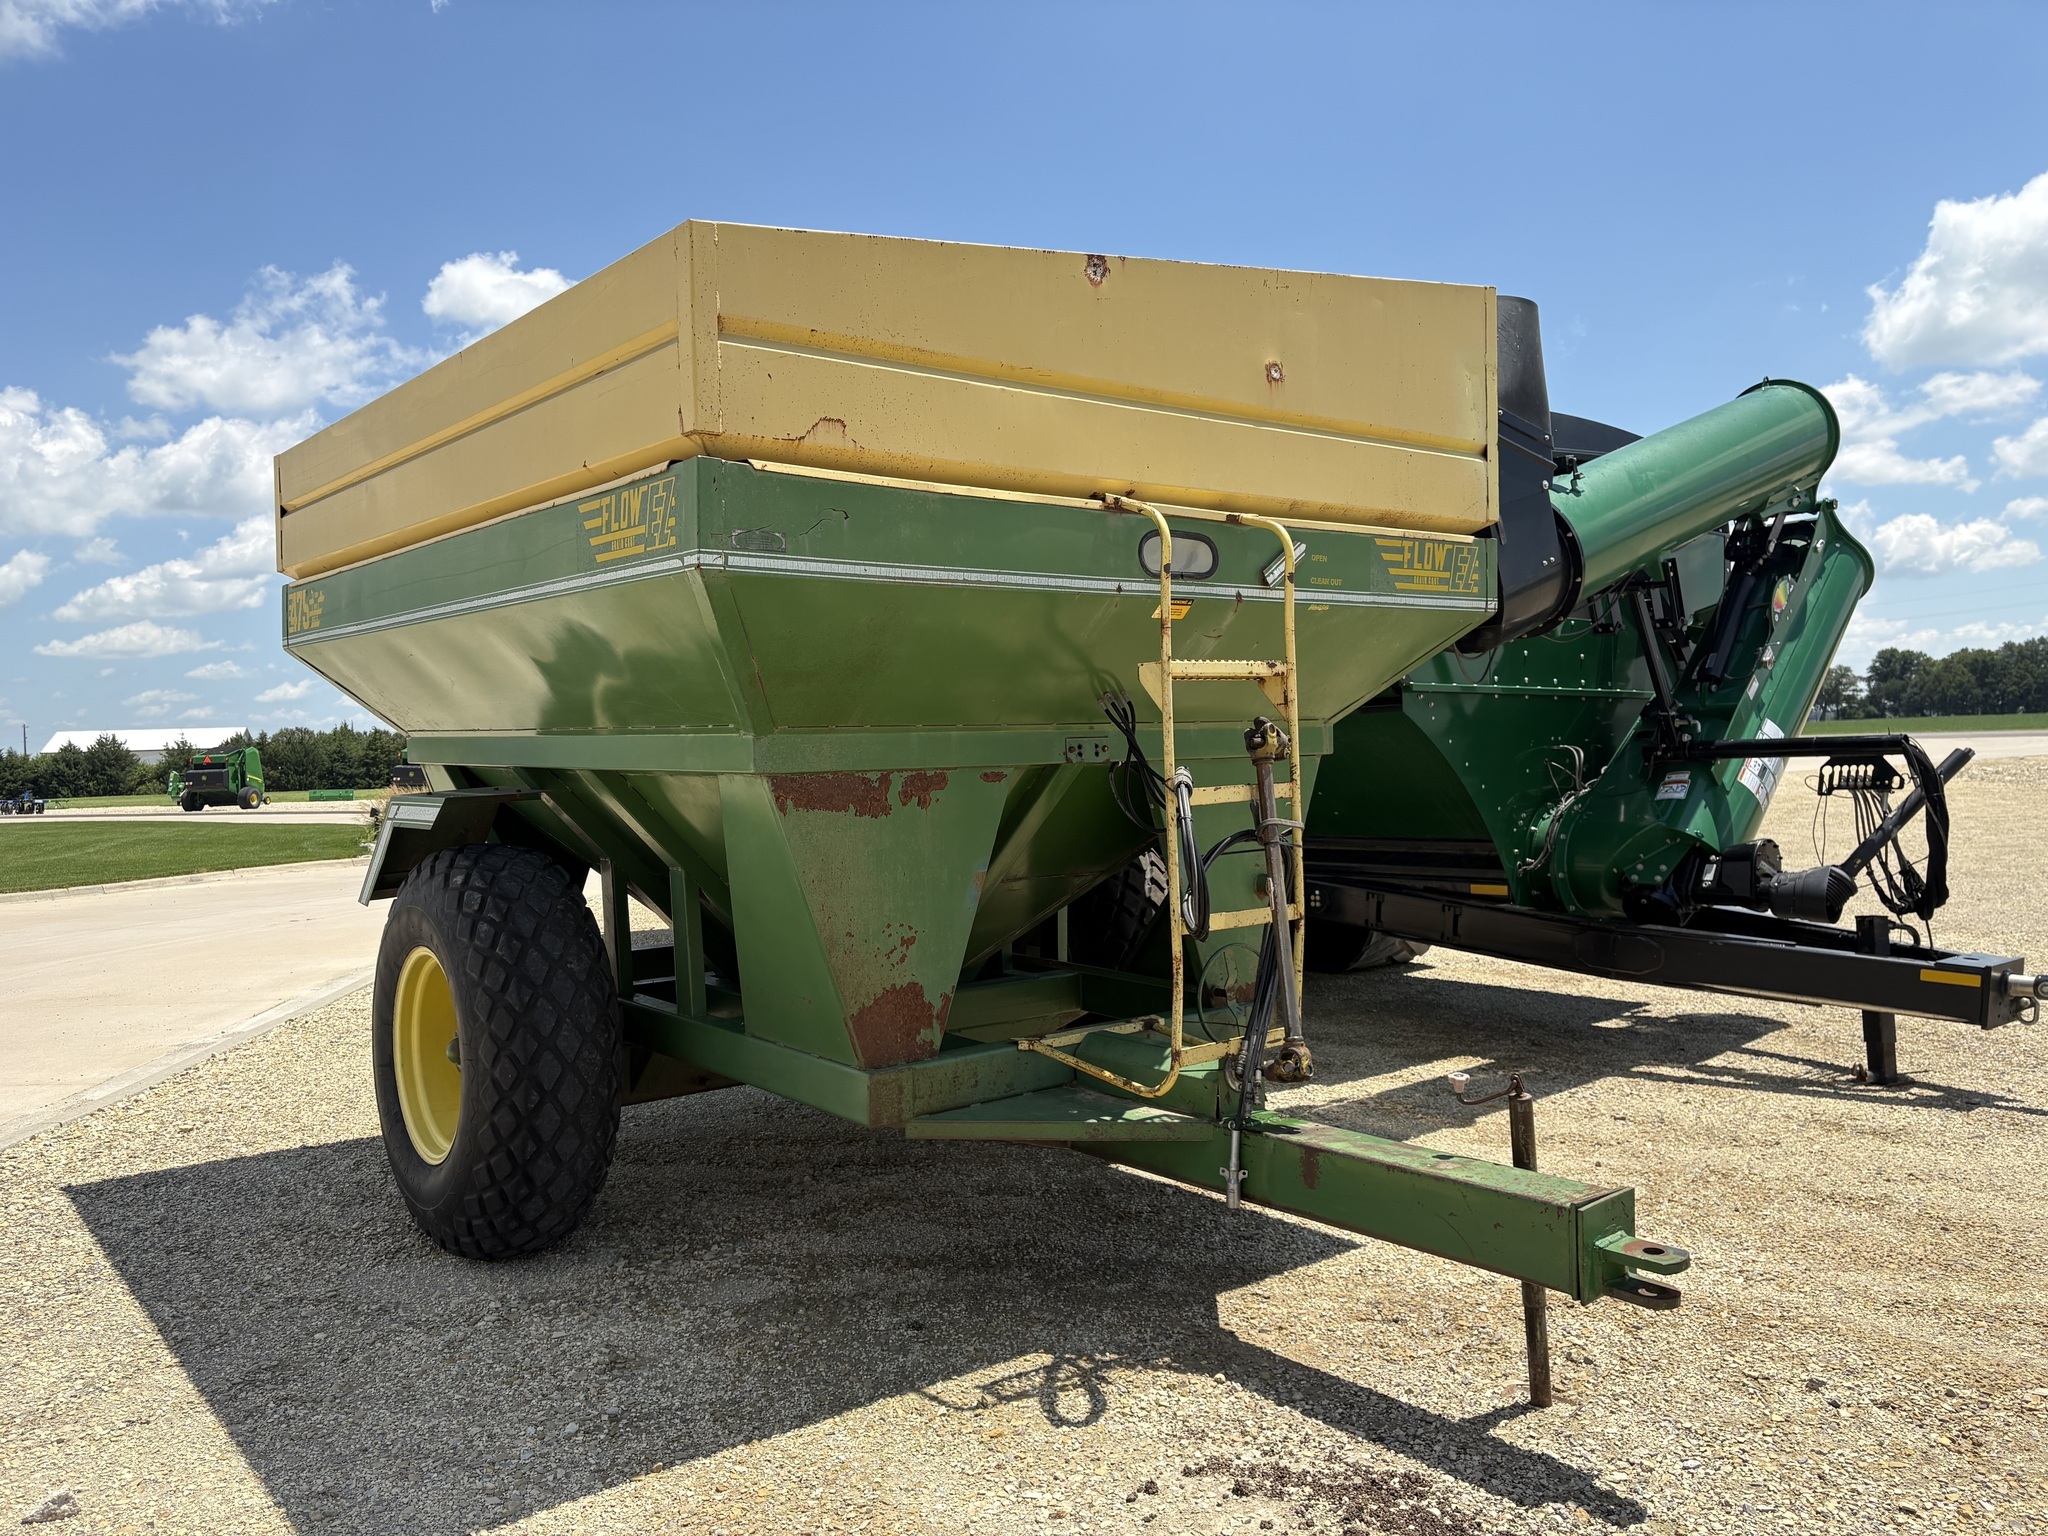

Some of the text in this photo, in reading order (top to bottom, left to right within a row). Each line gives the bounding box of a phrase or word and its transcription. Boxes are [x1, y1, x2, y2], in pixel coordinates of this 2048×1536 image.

[601, 485, 648, 534] FLOW
[1311, 554, 1328, 562] OPEN
[1402, 541, 1453, 571] FLOW
[1310, 577, 1342, 586] CLEAN OUT
